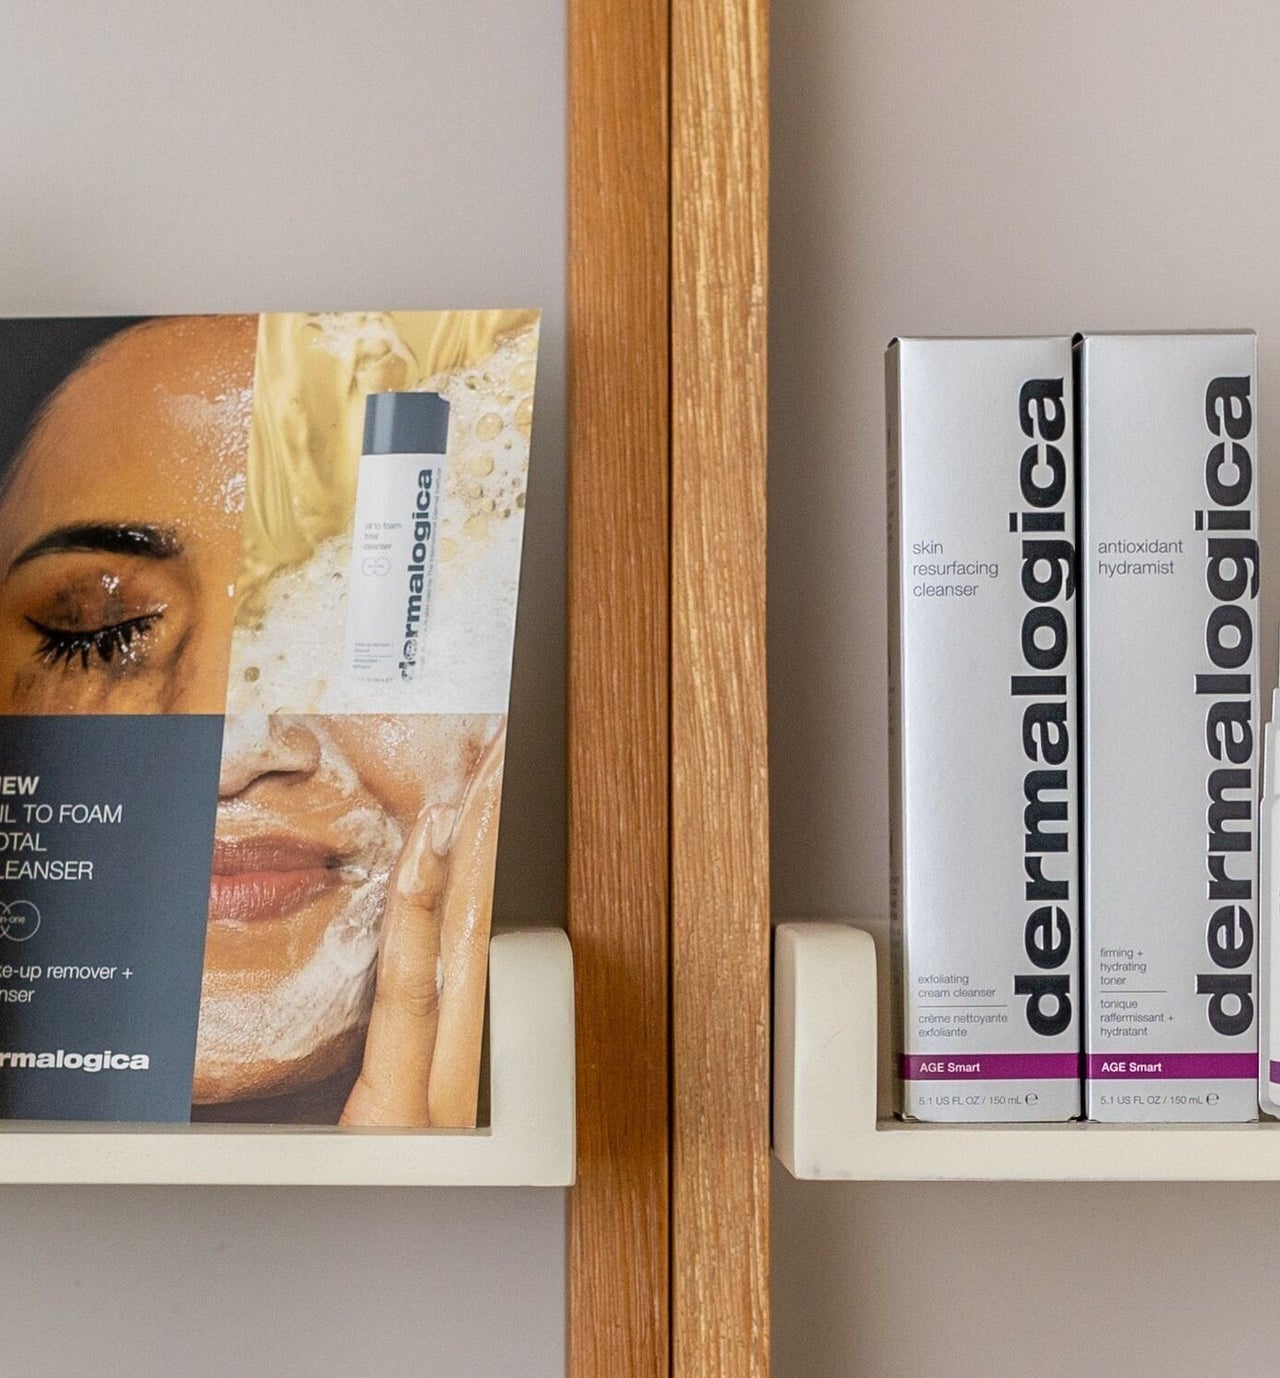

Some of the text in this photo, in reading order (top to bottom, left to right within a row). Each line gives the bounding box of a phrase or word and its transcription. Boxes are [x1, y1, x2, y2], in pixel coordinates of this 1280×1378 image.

[913, 542, 943, 555] skin
[1098, 539, 1182, 554] antioxidant
[913, 561, 998, 578] resurfacing
[1099, 561, 1174, 576] hydramist
[913, 582, 978, 596] cleanser
[1008, 377, 1076, 1037] dermalogica
[1194, 375, 1260, 1036] dermalogica
[23, 805, 52, 823] TO
[59, 805, 122, 823] FOAM
[47, 965, 116, 980] remover
[918, 974, 969, 985] exfoliating
[918, 988, 995, 998] cream cleanser
[920, 1062, 980, 1072] AGE Smart
